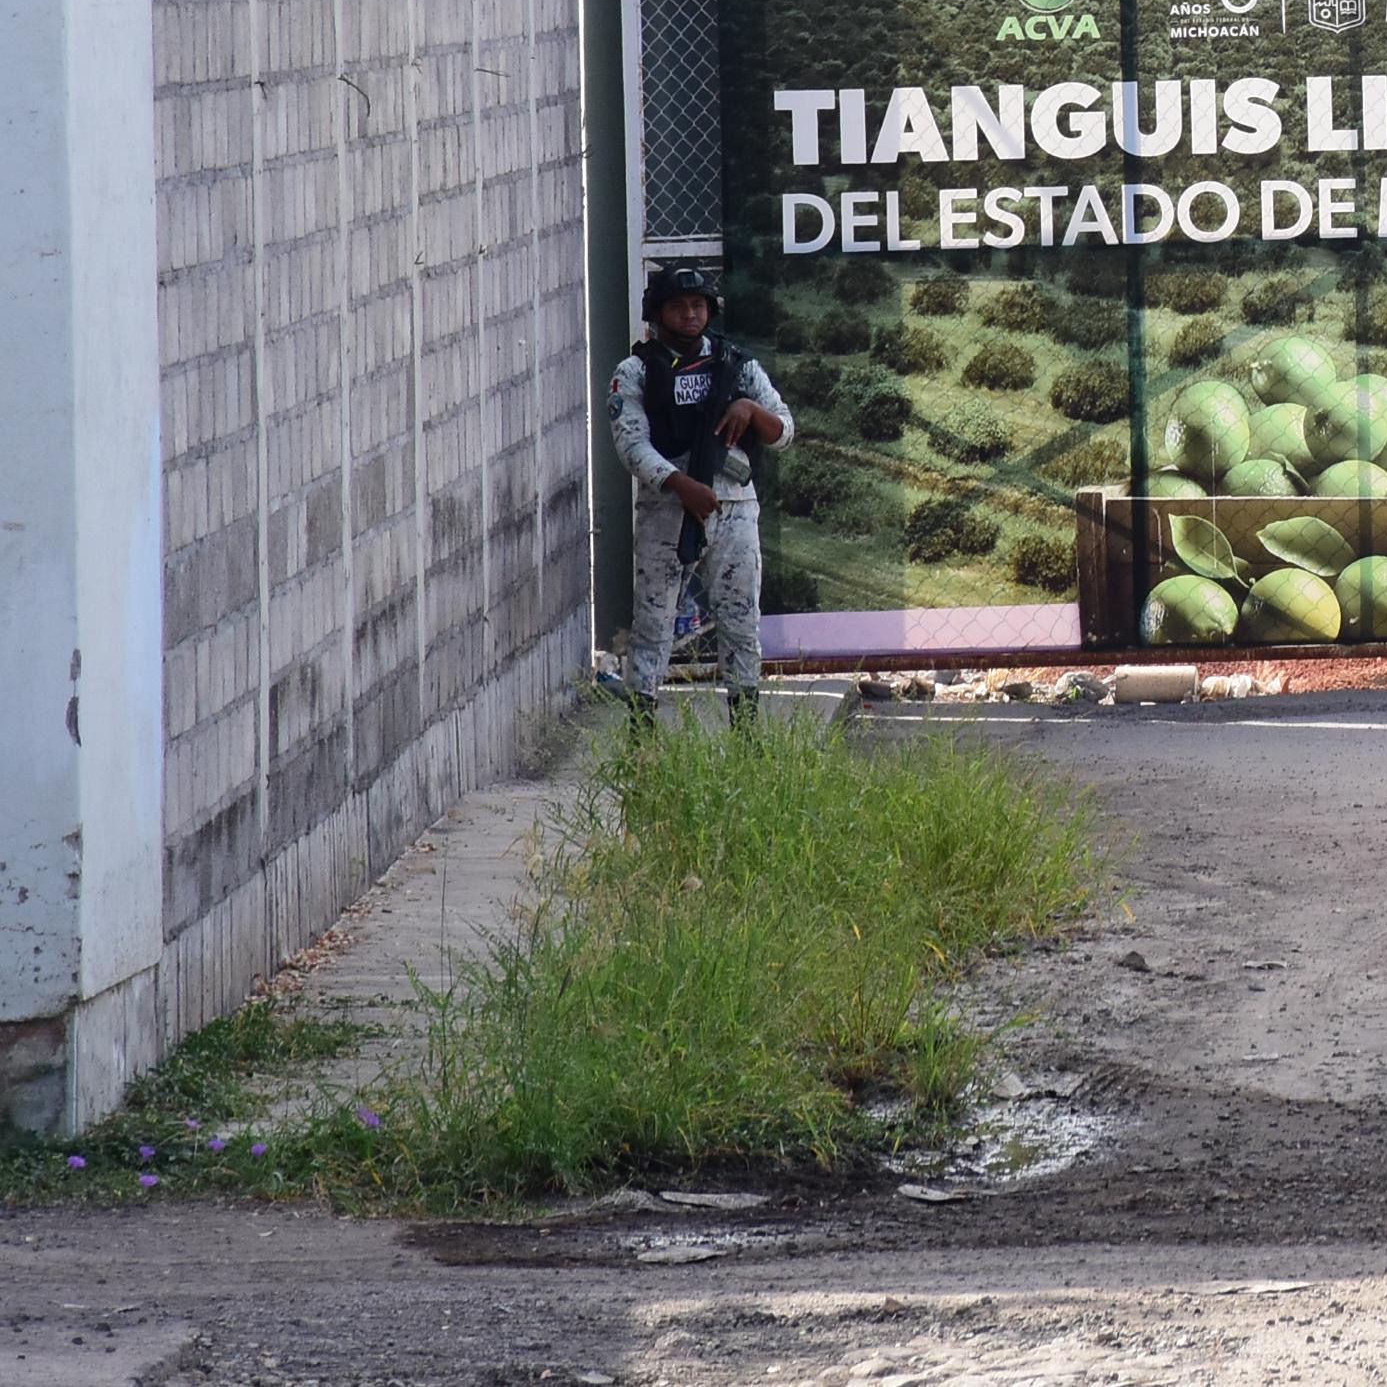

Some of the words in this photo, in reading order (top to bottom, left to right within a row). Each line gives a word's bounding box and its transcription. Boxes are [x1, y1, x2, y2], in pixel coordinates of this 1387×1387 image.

[1169, 1, 1211, 16] AÑOS
[995, 14, 1101, 41] ACVA
[1170, 23, 1260, 39] MICHOACÁN
[773, 77, 1283, 166] TIANGUIS
[781, 190, 921, 255] DEL
[939, 180, 1241, 251] ESTADO
[1260, 177, 1358, 242] DE
[680, 375, 712, 389] GUARD
[676, 388, 709, 403] NACIO
